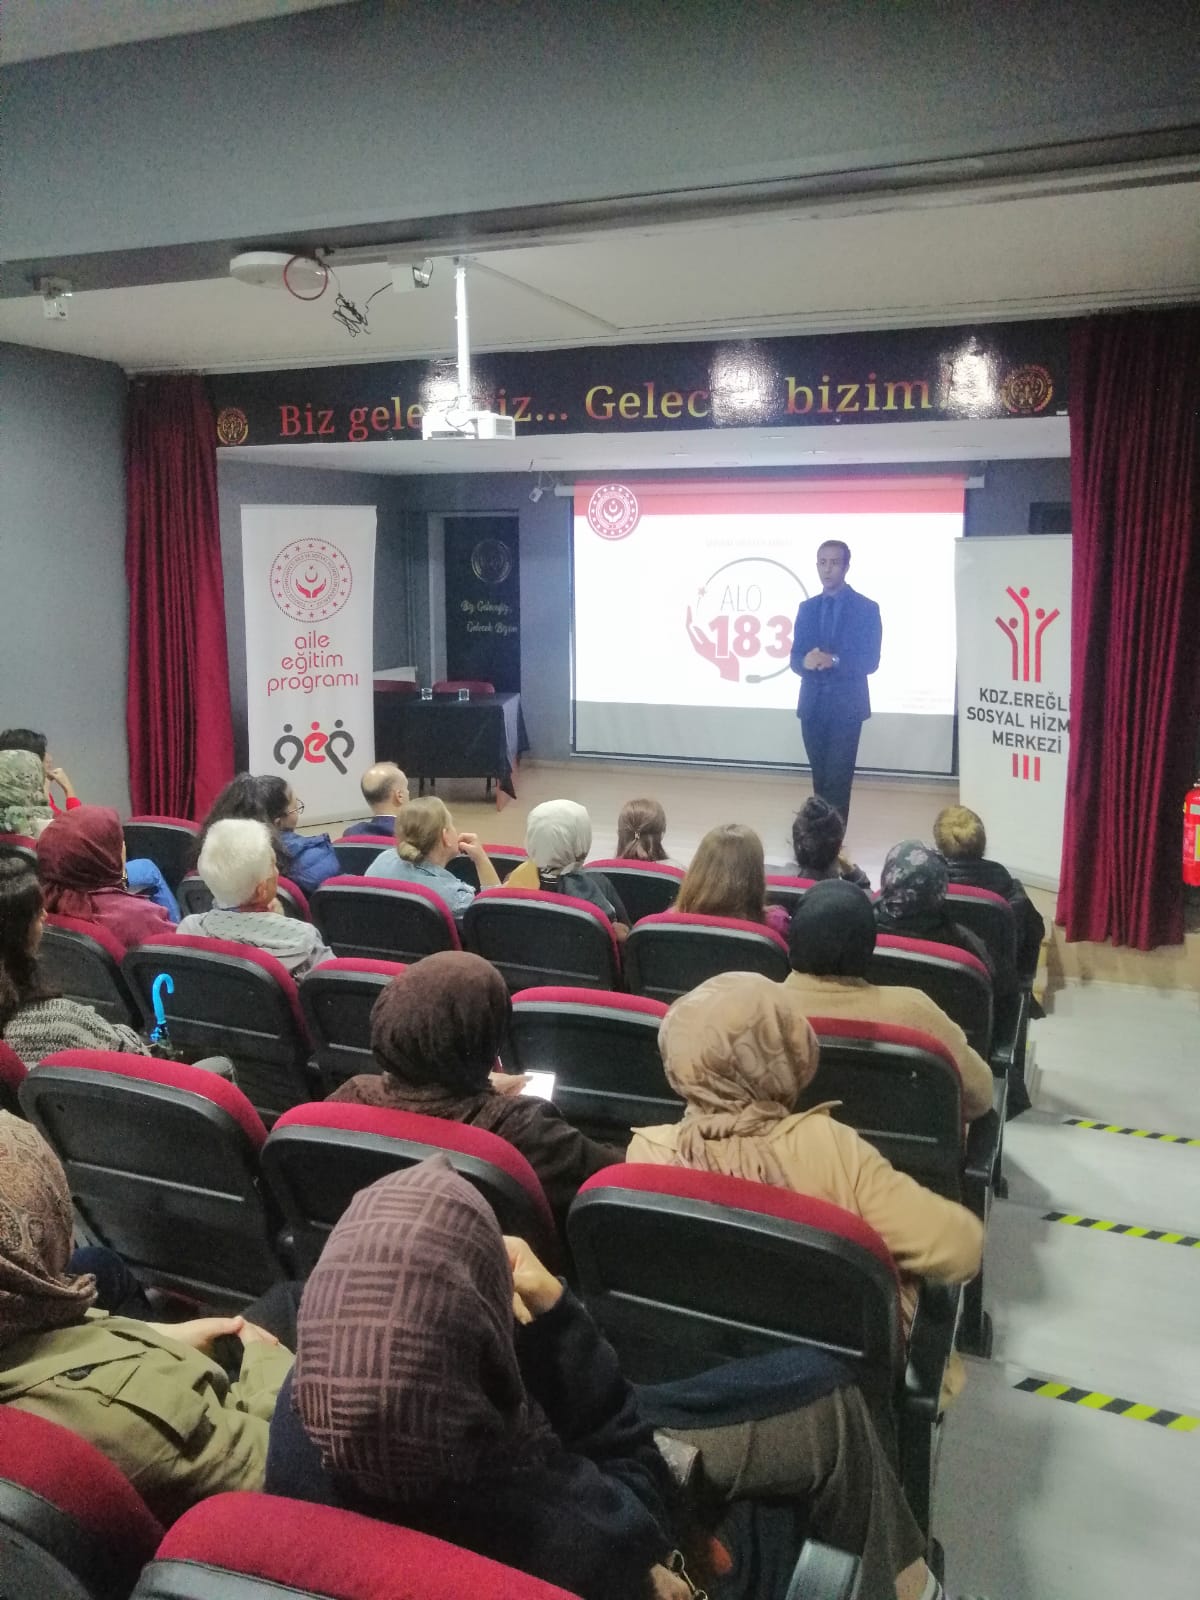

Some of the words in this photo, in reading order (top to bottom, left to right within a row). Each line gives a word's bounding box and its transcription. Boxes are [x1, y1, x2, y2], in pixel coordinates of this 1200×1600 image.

[279, 403, 335, 437] Biz
[347, 388, 569, 442] geleiz...
[585, 382, 745, 420] Gelec
[720, 584, 762, 612] ALO
[294, 630, 331, 650] aile
[708, 614, 793, 659] 183
[281, 650, 344, 675] eğitim
[267, 672, 359, 697] programı
[979, 687, 1070, 712] KDZ.EREĞL
[966, 706, 1025, 729] SOSYAL
[1030, 712, 1070, 734] HİZM
[992, 730, 1062, 755] MERKEZİ
